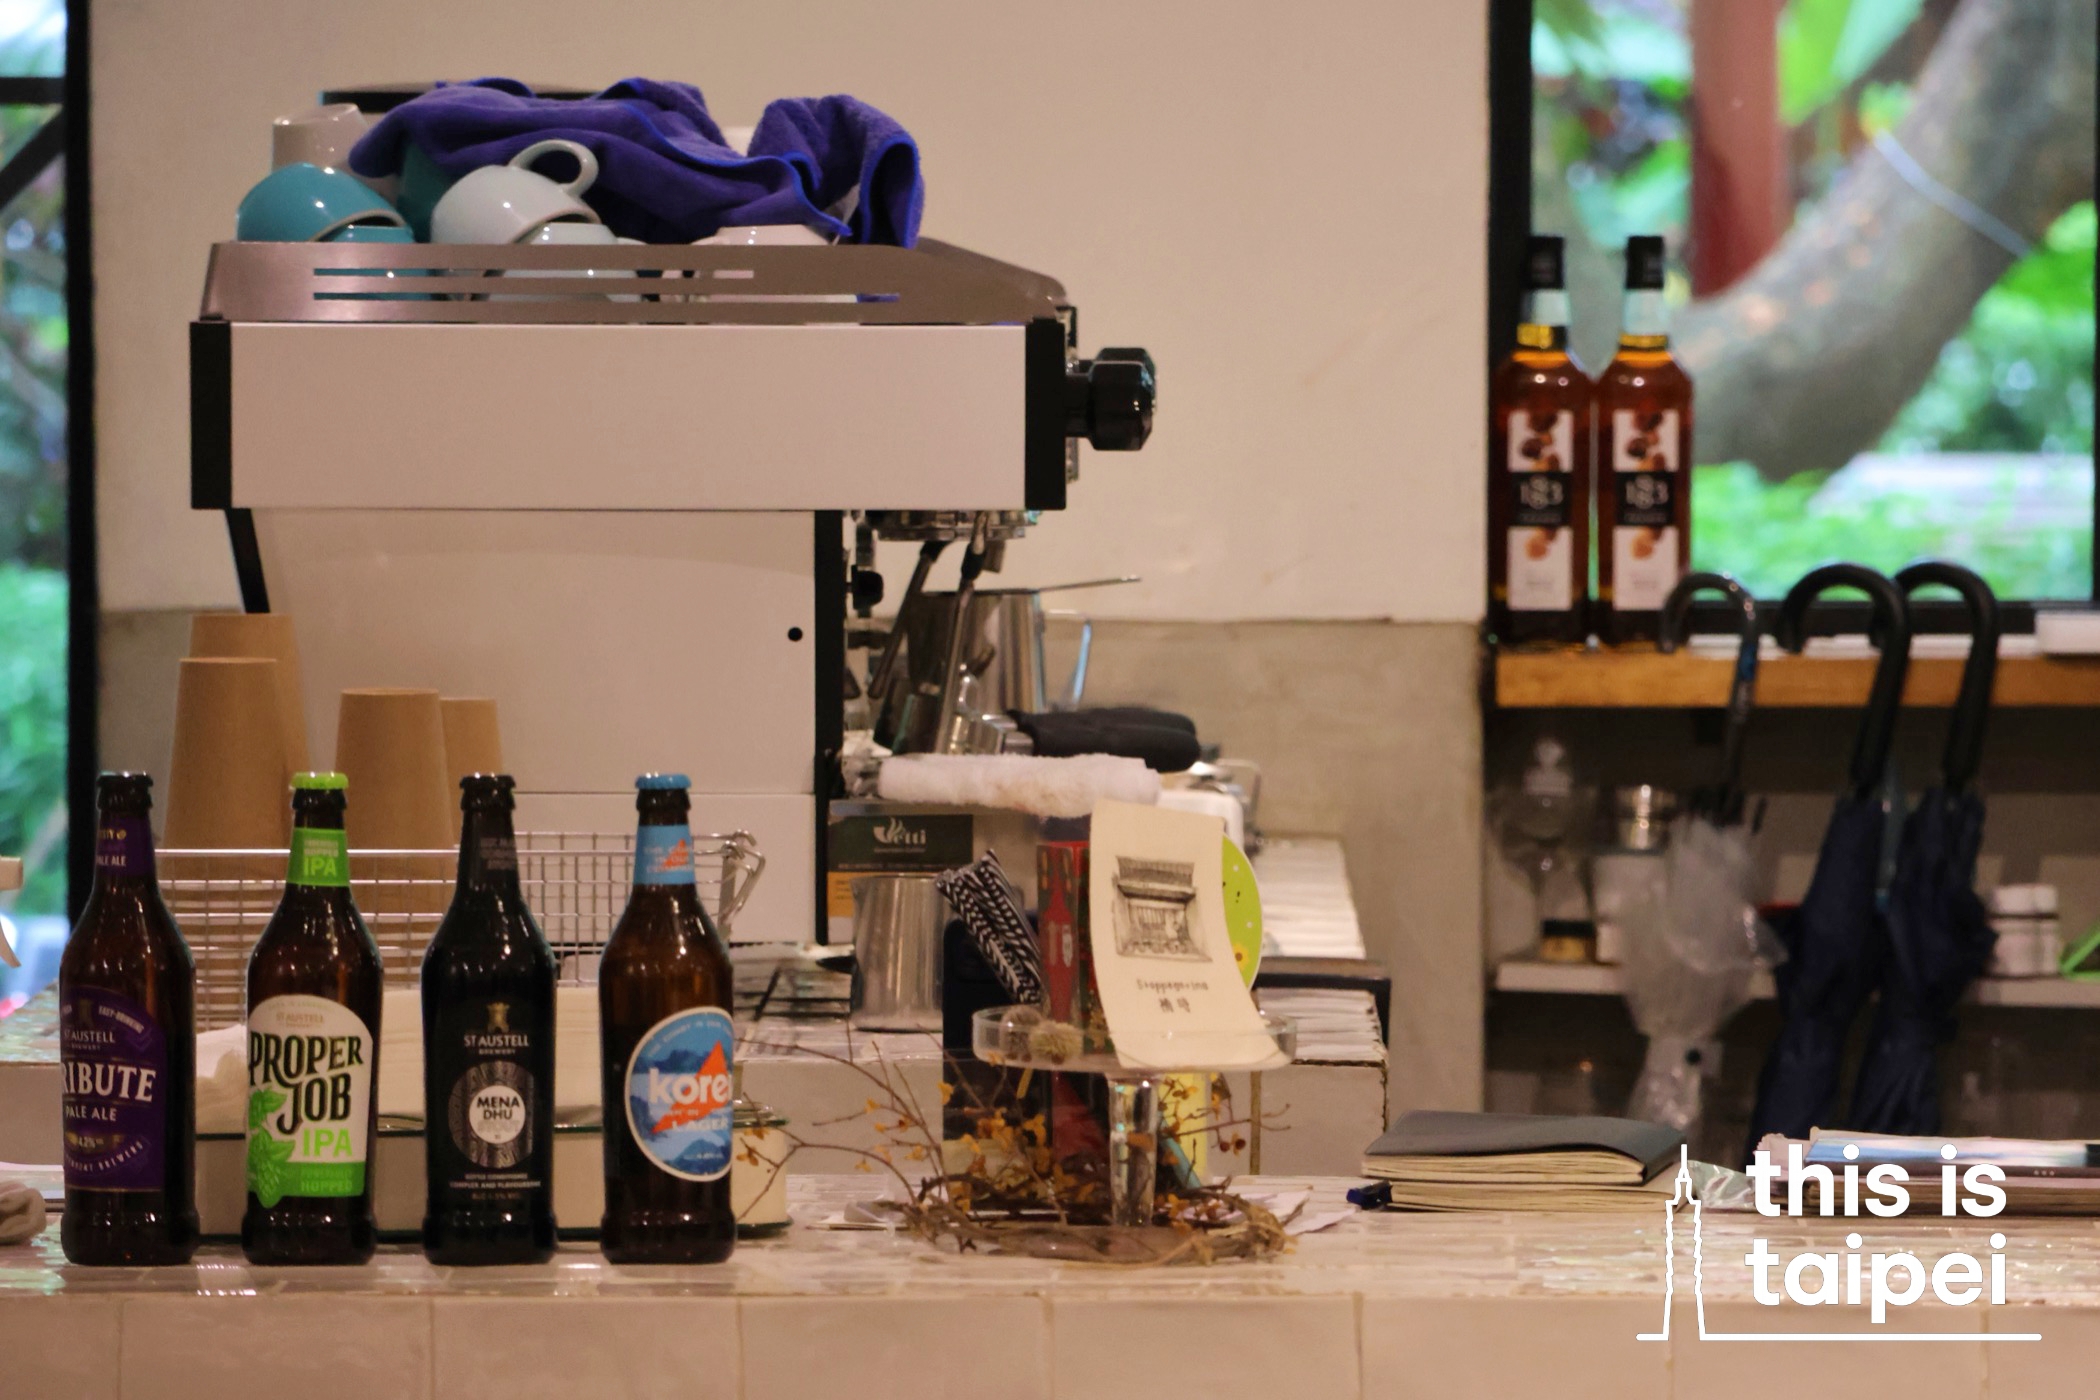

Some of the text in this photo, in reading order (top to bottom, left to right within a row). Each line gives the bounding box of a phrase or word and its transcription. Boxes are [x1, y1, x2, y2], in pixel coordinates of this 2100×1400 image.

[303, 857, 337, 877] IPA
[71, 1030, 116, 1044] AUSTELL
[479, 1034, 529, 1047] AUSTELL
[249, 1029, 363, 1088] PROPER
[276, 1071, 352, 1135] JOB
[477, 1096, 520, 1108] MENA
[65, 1105, 118, 1122] PALE ALE
[483, 1109, 513, 1120] DHU
[303, 1128, 353, 1158] IPA
